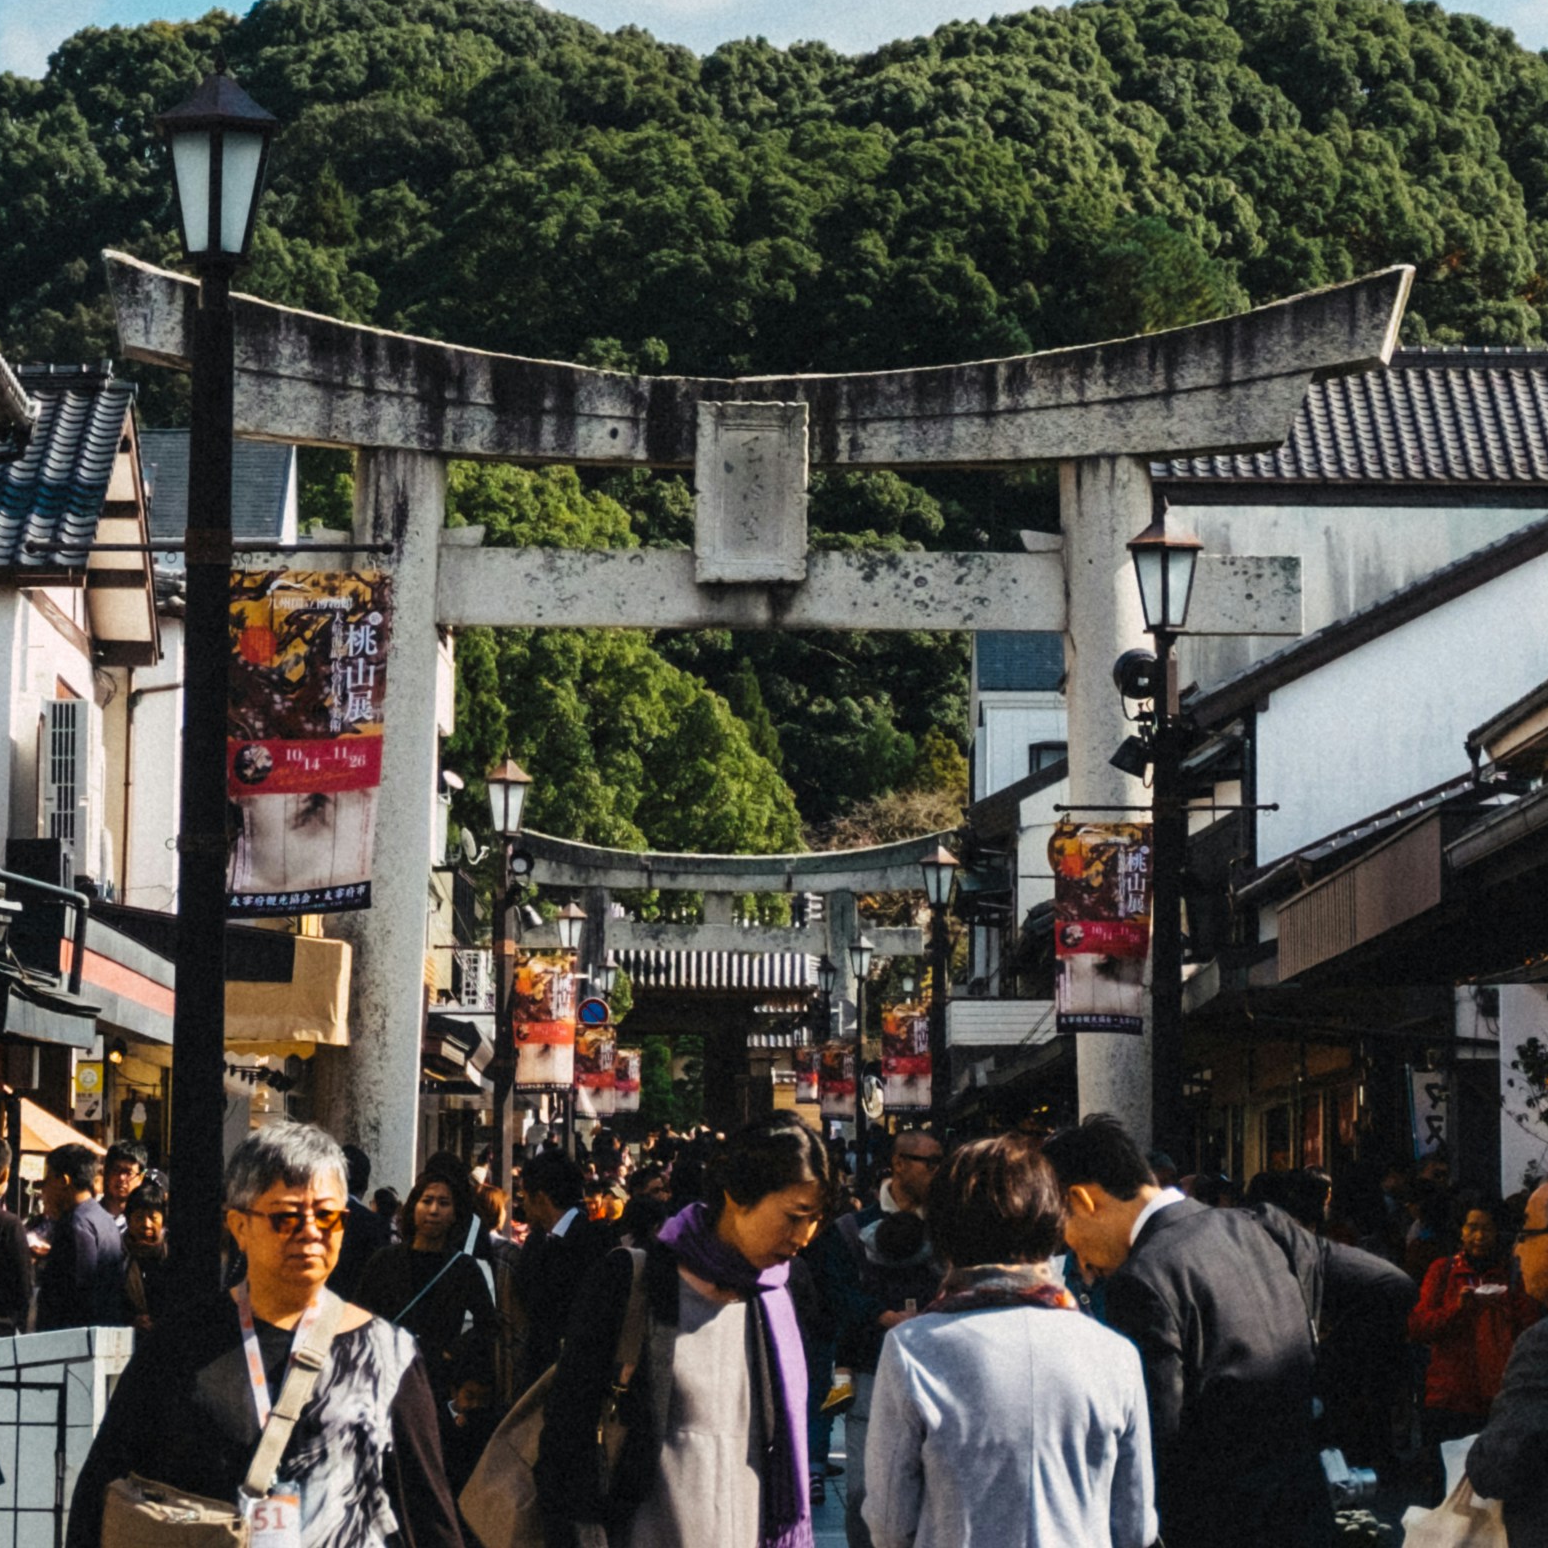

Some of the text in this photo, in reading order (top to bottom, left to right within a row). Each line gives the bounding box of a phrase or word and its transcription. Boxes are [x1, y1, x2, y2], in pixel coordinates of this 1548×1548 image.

[344, 624, 378, 723] 桃山展
[252, 1507, 286, 1531] 51
